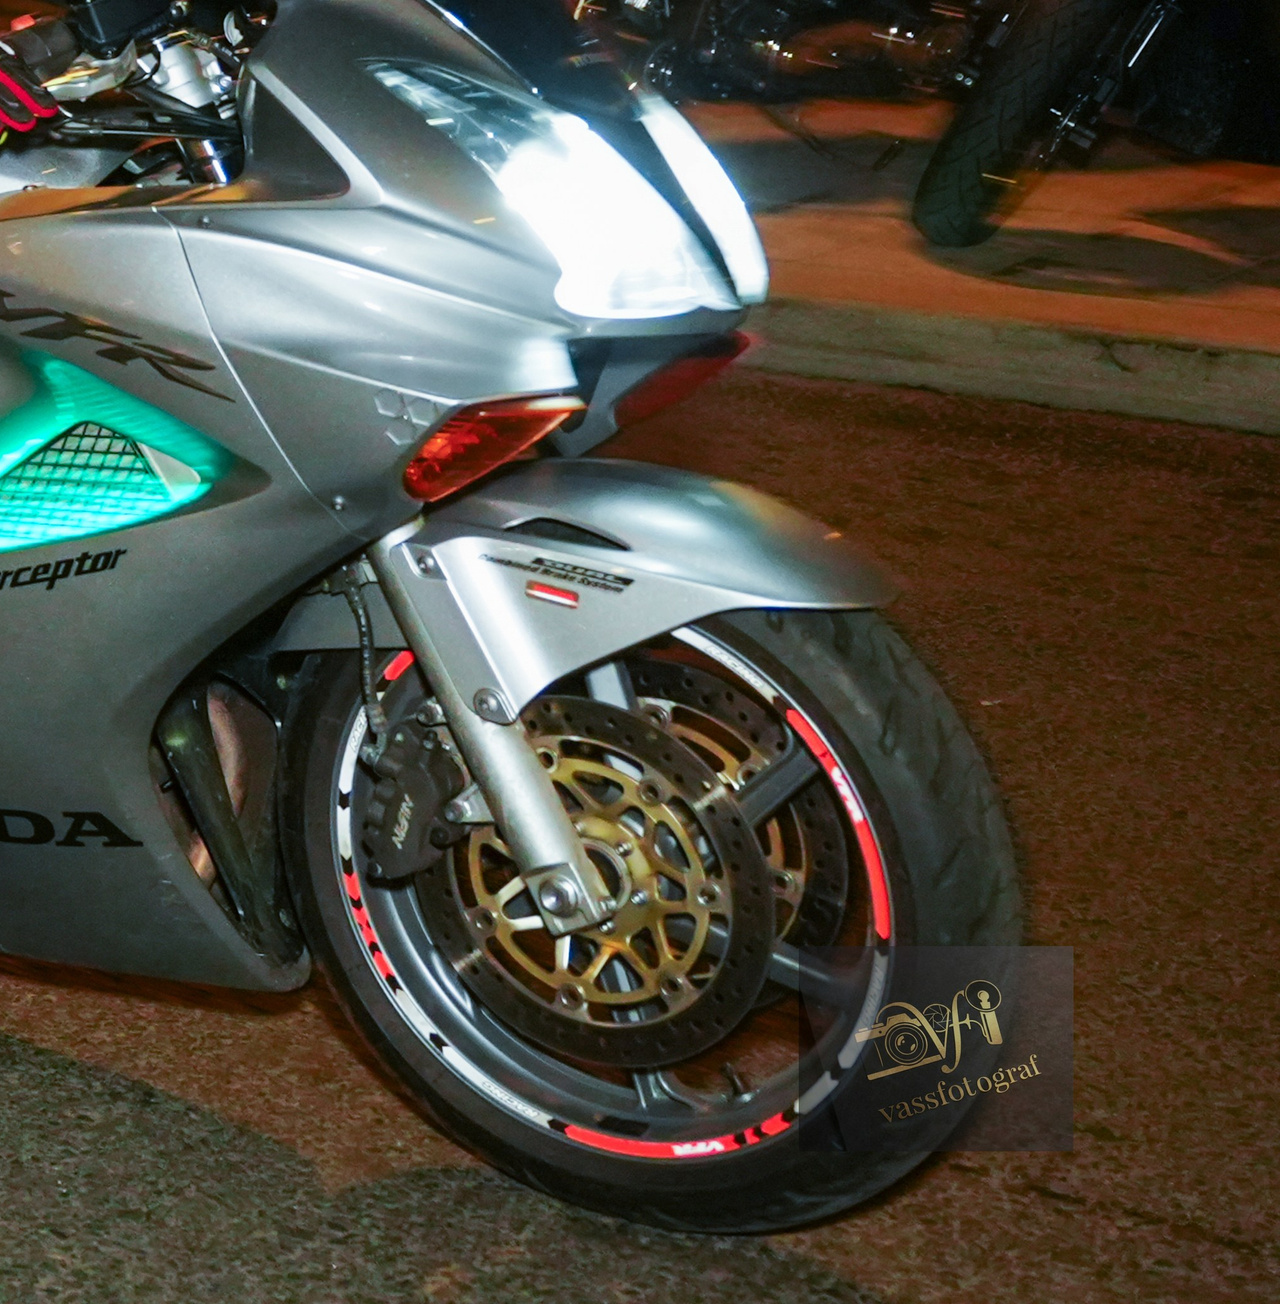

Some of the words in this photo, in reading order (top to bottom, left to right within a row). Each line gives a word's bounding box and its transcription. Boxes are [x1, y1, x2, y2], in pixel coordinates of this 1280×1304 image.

[539, 565, 577, 582] Brake
[577, 575, 624, 593] System
[703, 644, 763, 689] RACING
[830, 765, 865, 823] VFR
[481, 1081, 540, 1117] RACING
[672, 1140, 725, 1156] VFR
